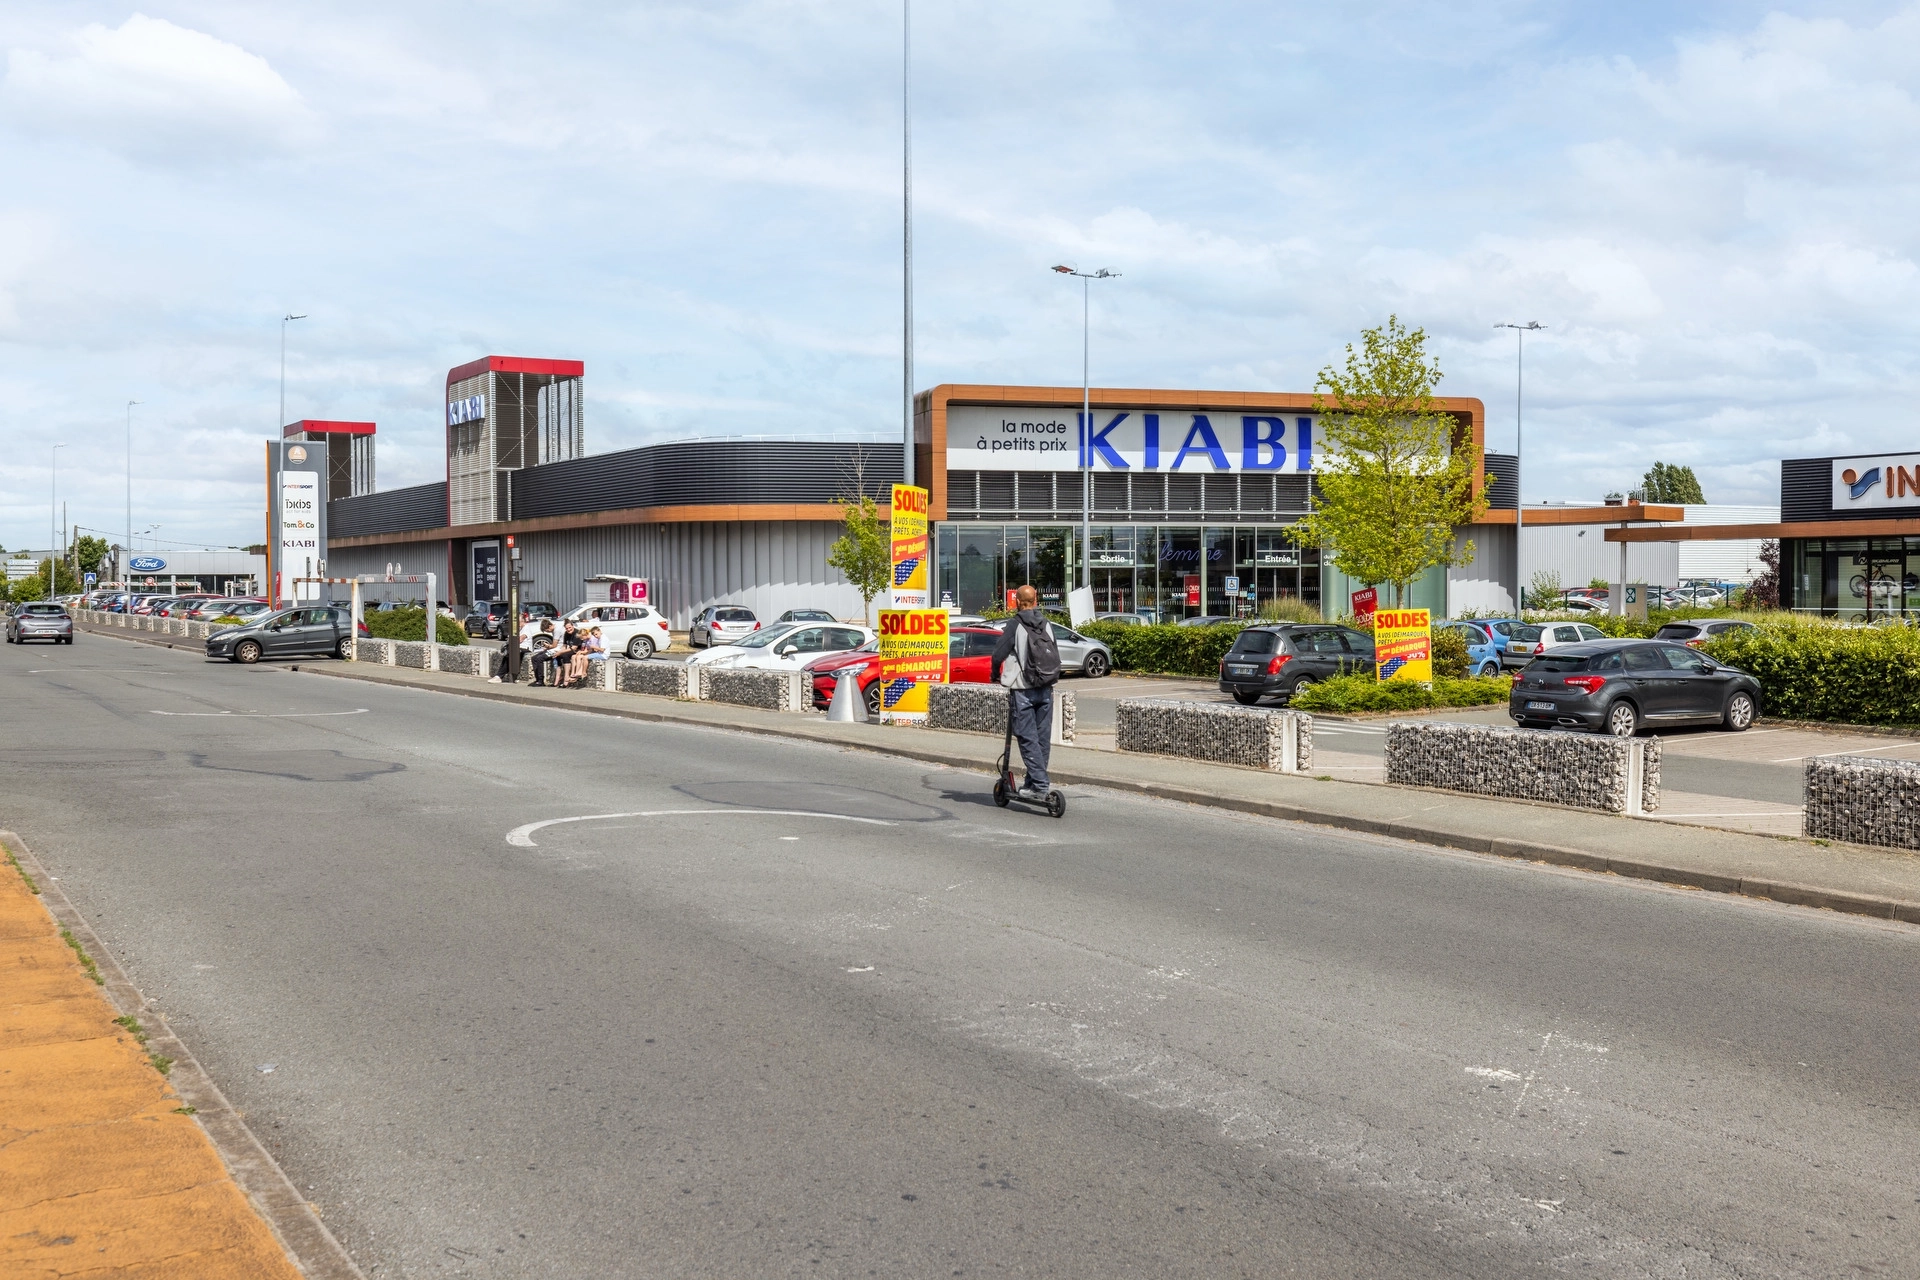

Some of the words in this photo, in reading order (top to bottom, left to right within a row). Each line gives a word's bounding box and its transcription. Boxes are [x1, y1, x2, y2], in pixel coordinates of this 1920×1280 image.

[448, 395, 485, 425] KIABI
[1001, 419, 1016, 434] la
[1020, 420, 1067, 434] mode
[976, 436, 987, 450] à
[991, 437, 1035, 452] petits
[1039, 438, 1067, 453] prix
[1076, 412, 1312, 470] KIABI
[894, 489, 927, 514] SOLDES
[135, 559, 158, 568] Ford
[1100, 554, 1125, 563] Sortie
[1265, 555, 1291, 563] Entrée
[1354, 591, 1372, 601] KIABI
[881, 614, 946, 635] SOLDES
[1377, 612, 1428, 629] SOLDES
[896, 660, 943, 674] DÉMARQUE
